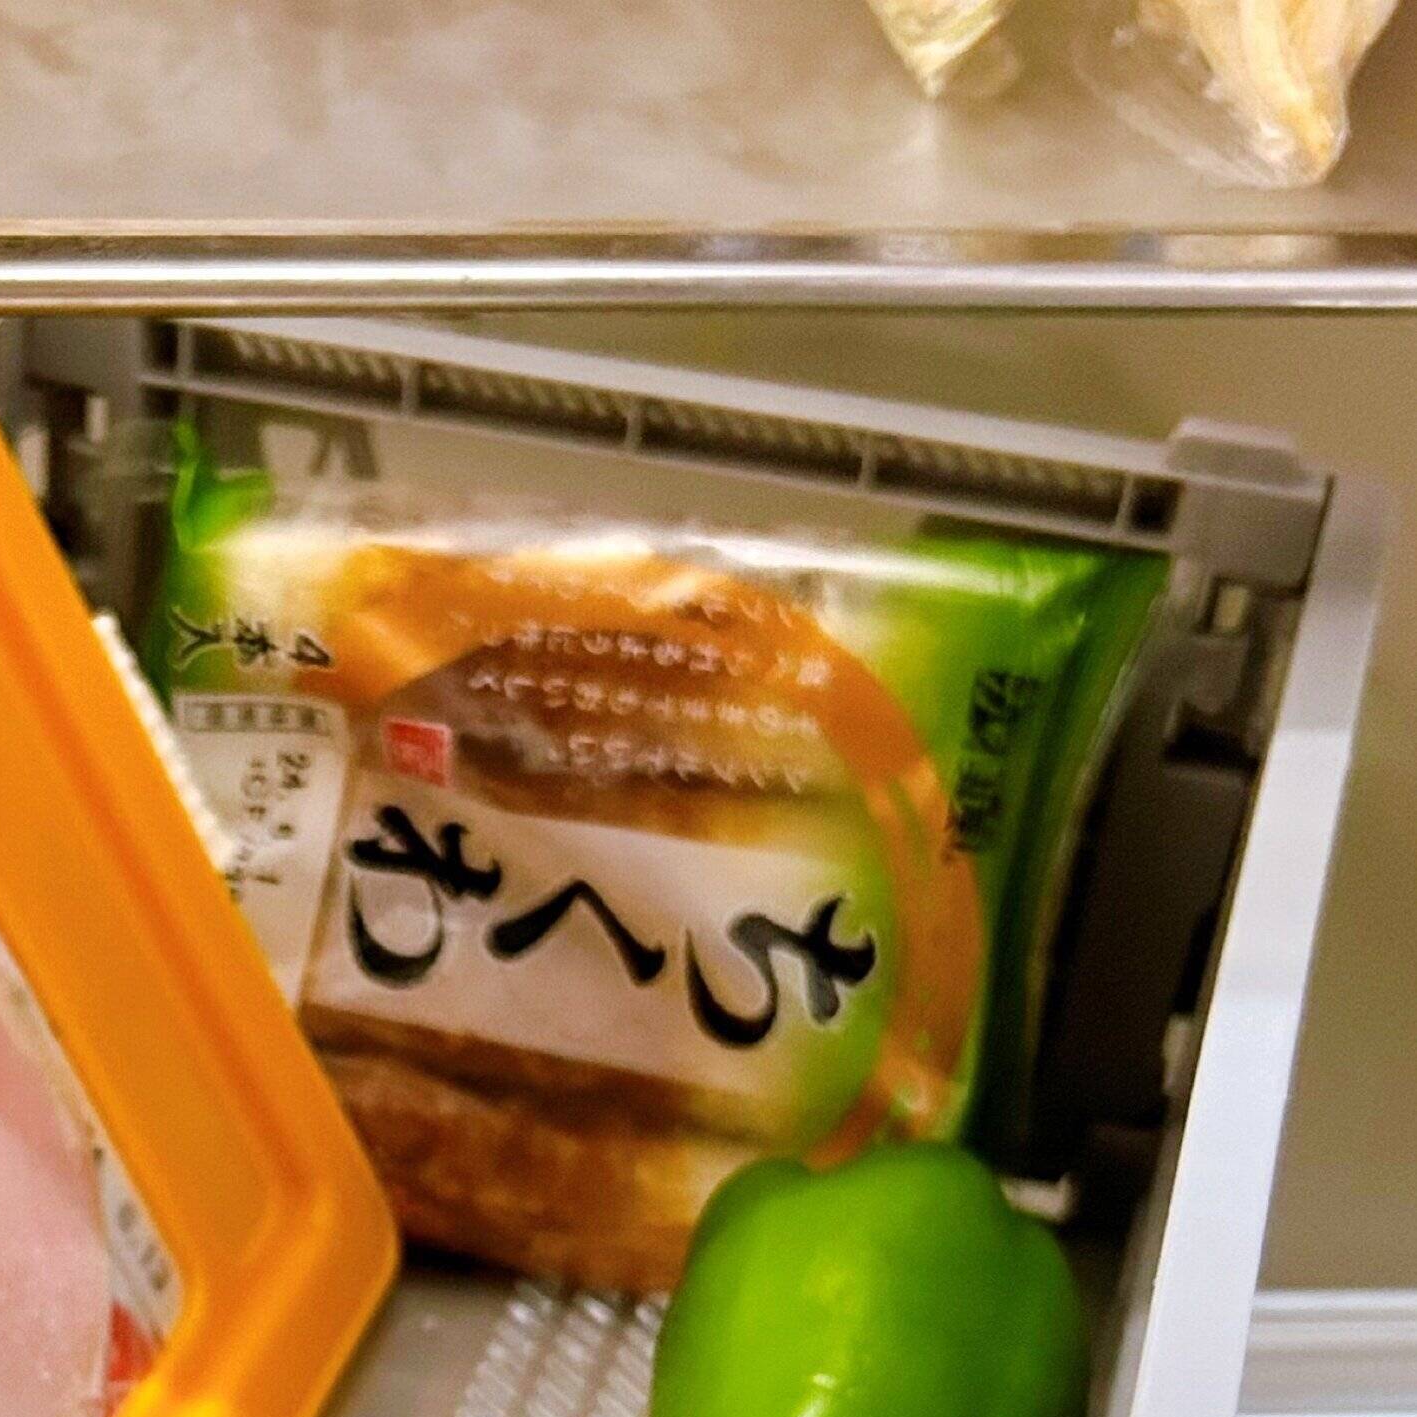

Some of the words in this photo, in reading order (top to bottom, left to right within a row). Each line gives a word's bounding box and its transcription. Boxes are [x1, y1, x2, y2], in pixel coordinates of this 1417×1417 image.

[171, 606, 335, 673] 4本入
[346, 804, 877, 1048] ちくわ
